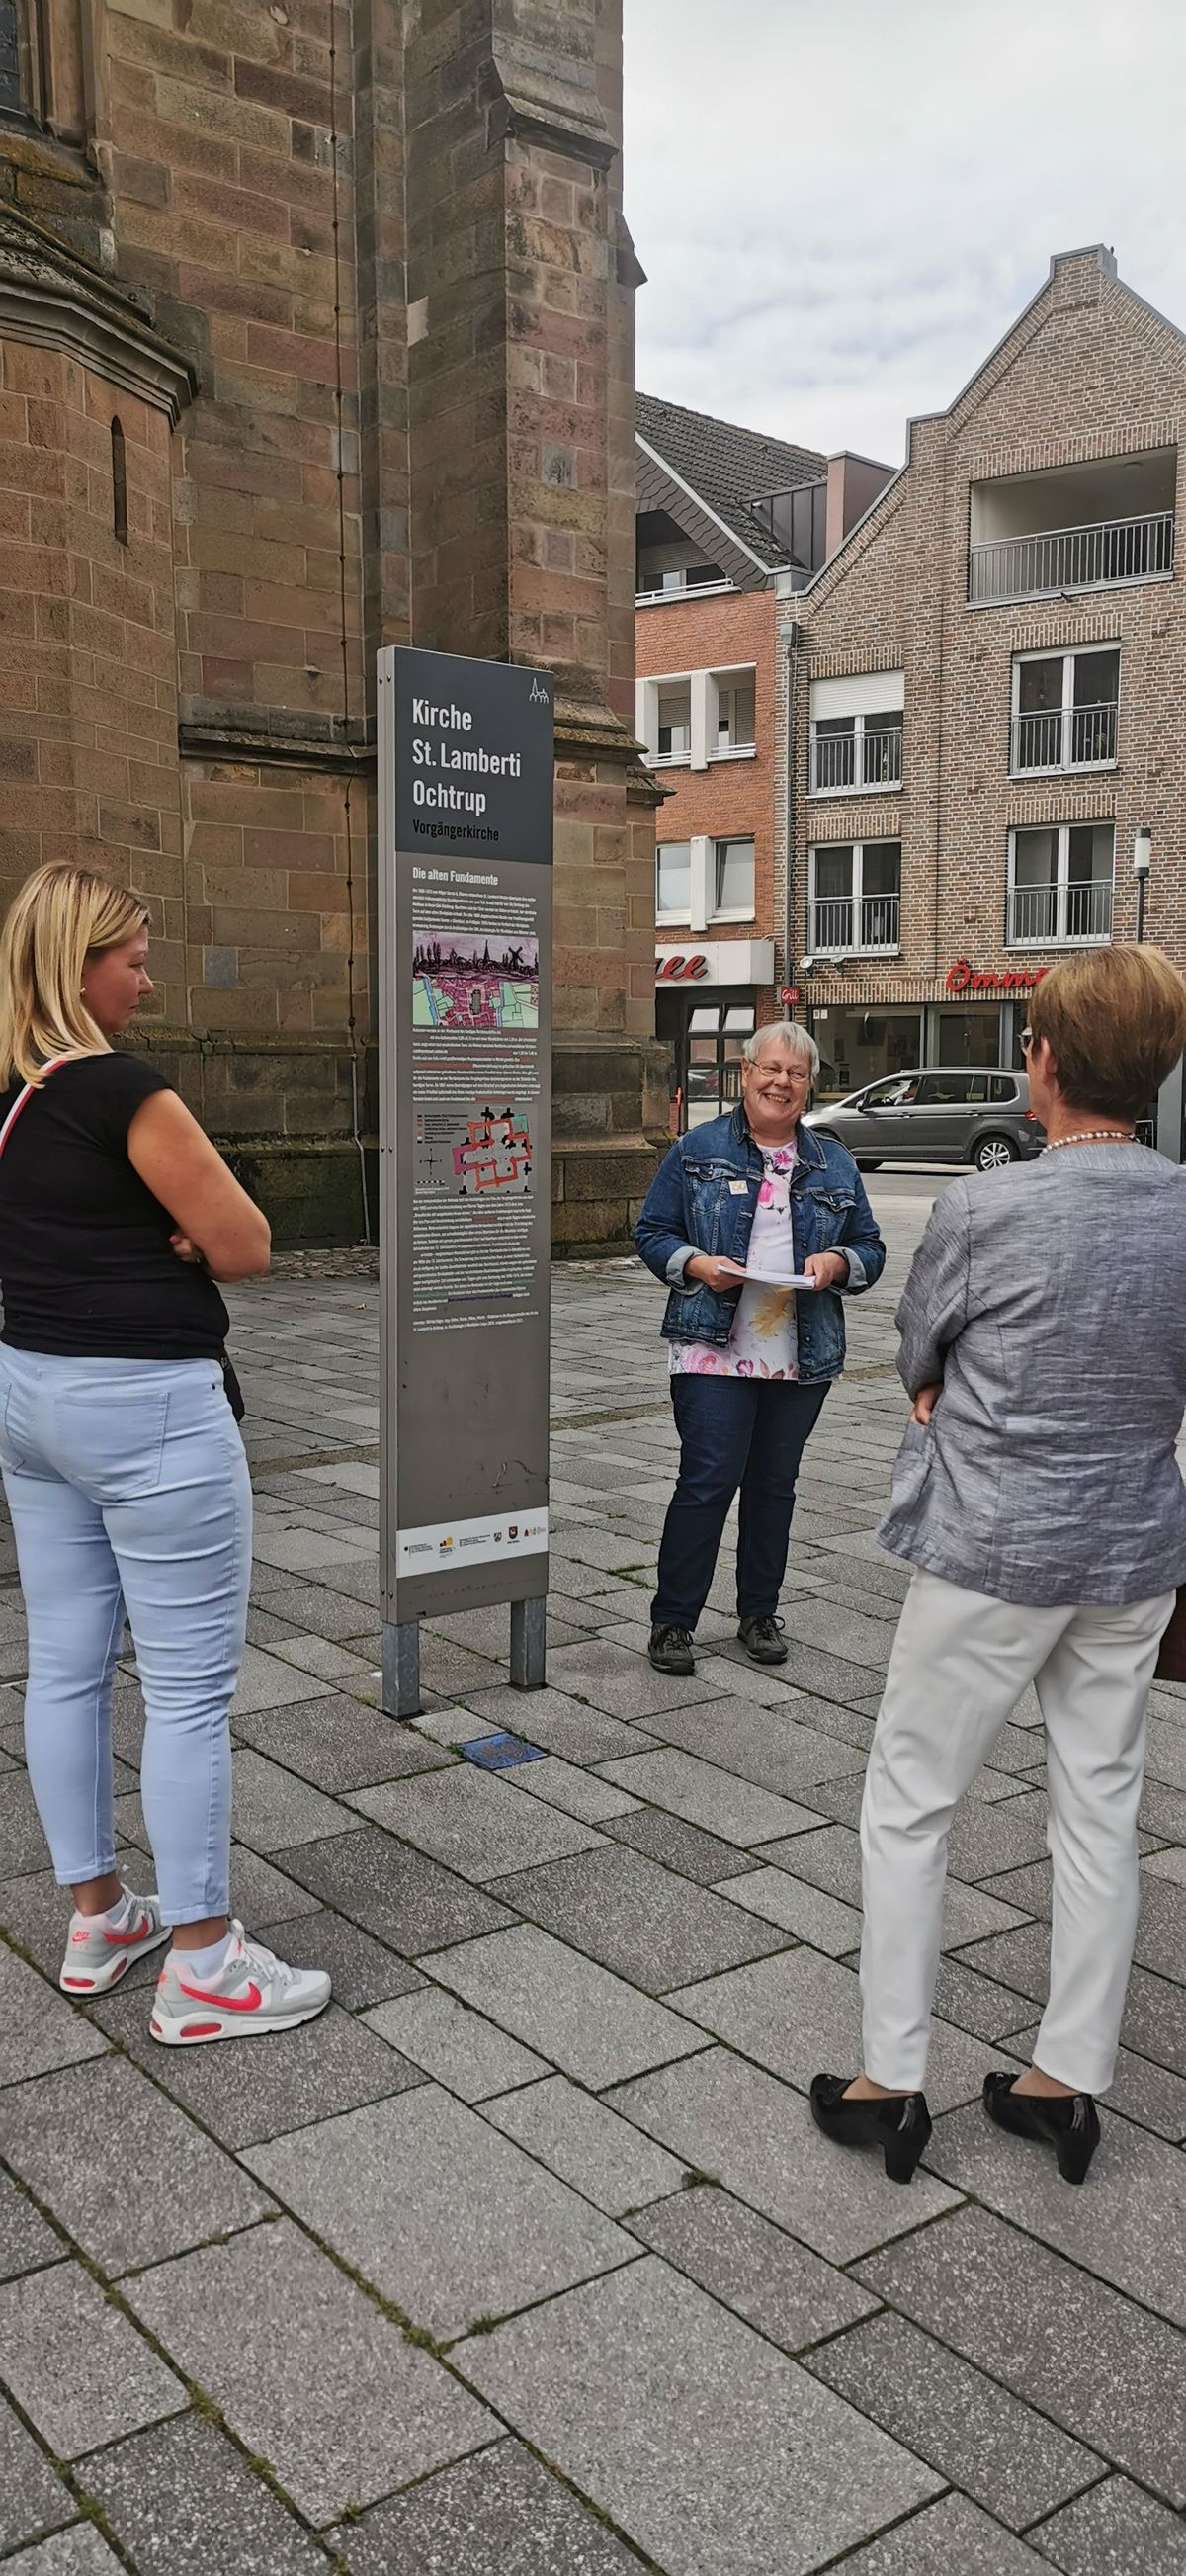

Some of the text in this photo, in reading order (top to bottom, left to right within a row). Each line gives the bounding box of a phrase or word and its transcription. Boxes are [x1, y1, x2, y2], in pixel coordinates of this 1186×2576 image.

[412, 698, 472, 731] Kirche
[412, 738, 521, 777] St. Lamberti
[412, 779, 486, 817] Ochtrup
[412, 818, 499, 842] Vorgängerkirche
[412, 866, 499, 886] Die alten Fundamente
[781, 988, 800, 1000] Grill
